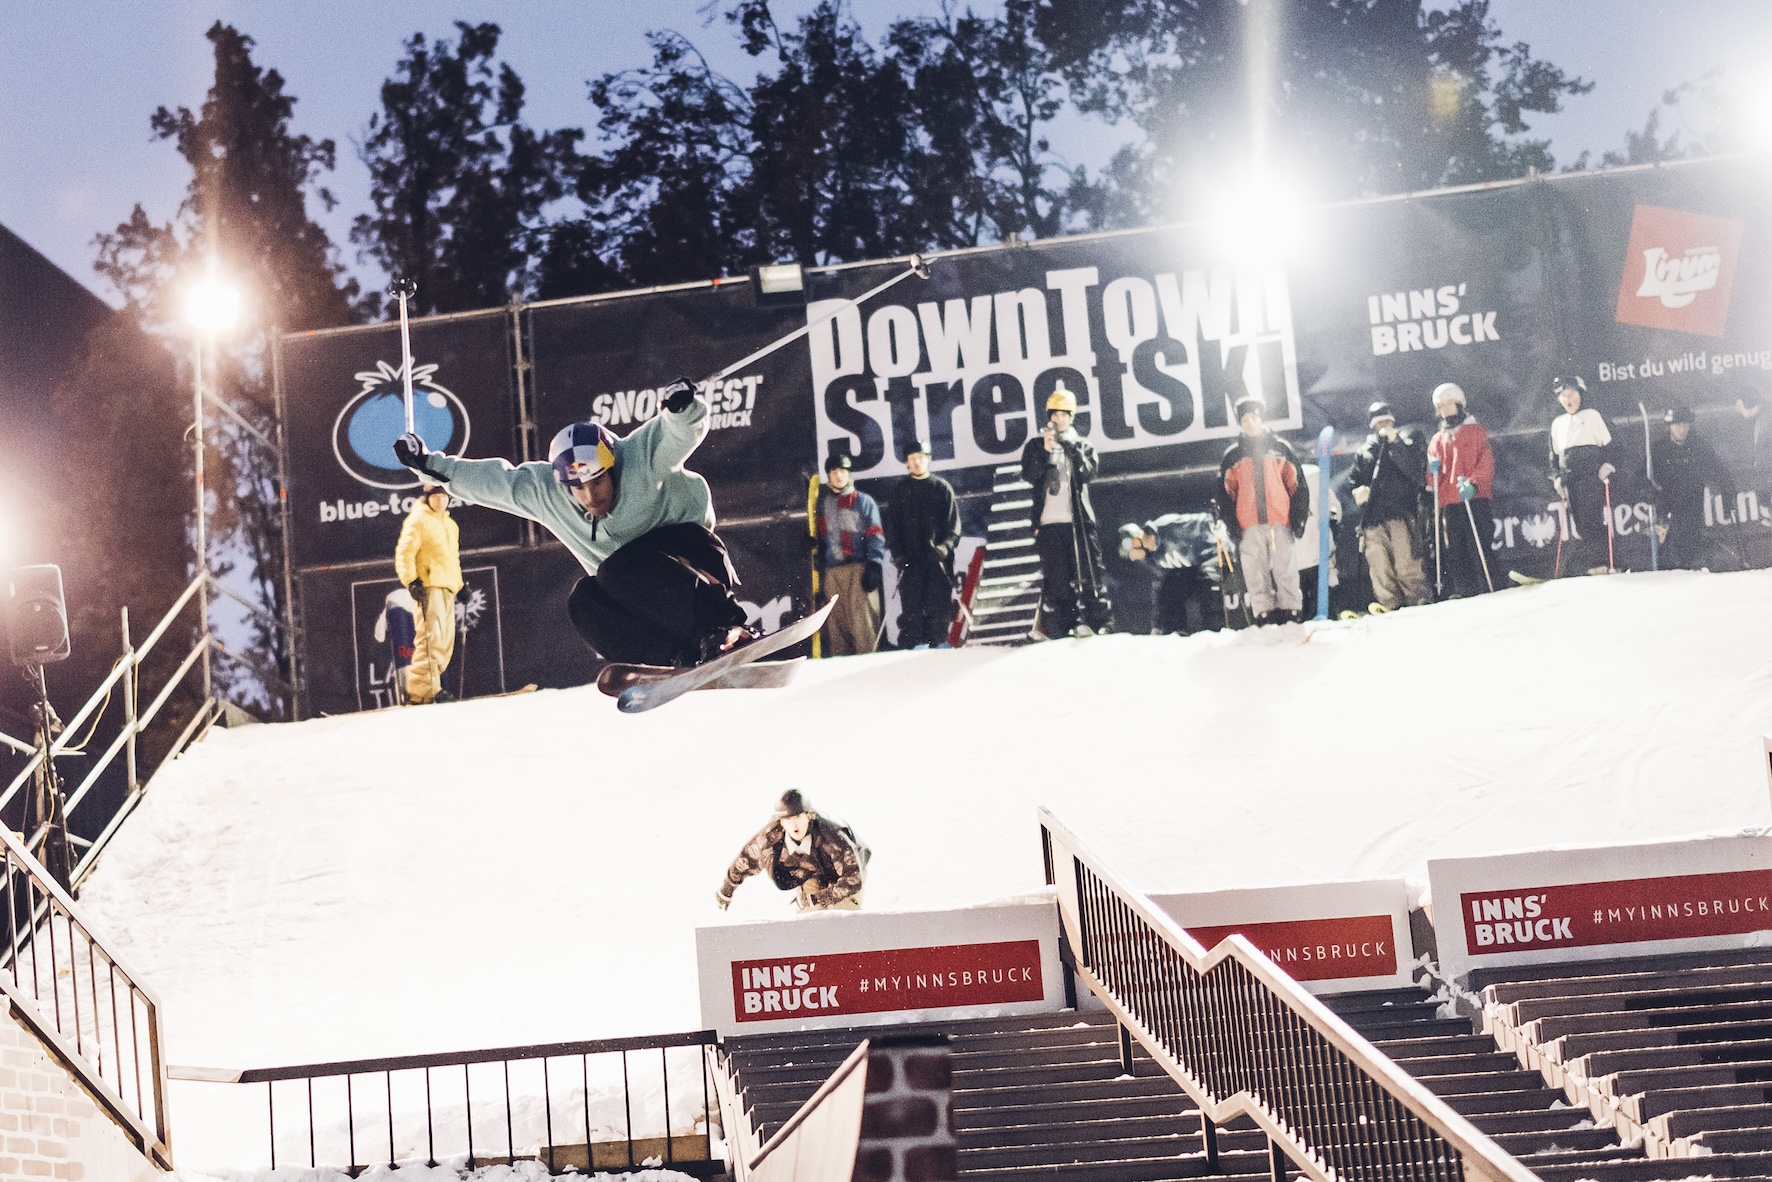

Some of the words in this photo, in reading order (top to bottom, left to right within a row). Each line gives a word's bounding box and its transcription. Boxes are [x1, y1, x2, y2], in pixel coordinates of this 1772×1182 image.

[1367, 283, 1467, 325] INNS'
[1371, 311, 1501, 356] BRUCK
[1599, 362, 1636, 382] Bist
[1640, 359, 1664, 378] du
[1668, 352, 1706, 374] wild
[1471, 893, 1548, 922] INNS'
[1593, 896, 1770, 924] #MYINNSBRUCK
[1474, 917, 1574, 946] BRUCK
[741, 962, 816, 990] INNS'
[859, 966, 1033, 993] #MYINNSBRUCK
[743, 985, 840, 1014] BRUCK
